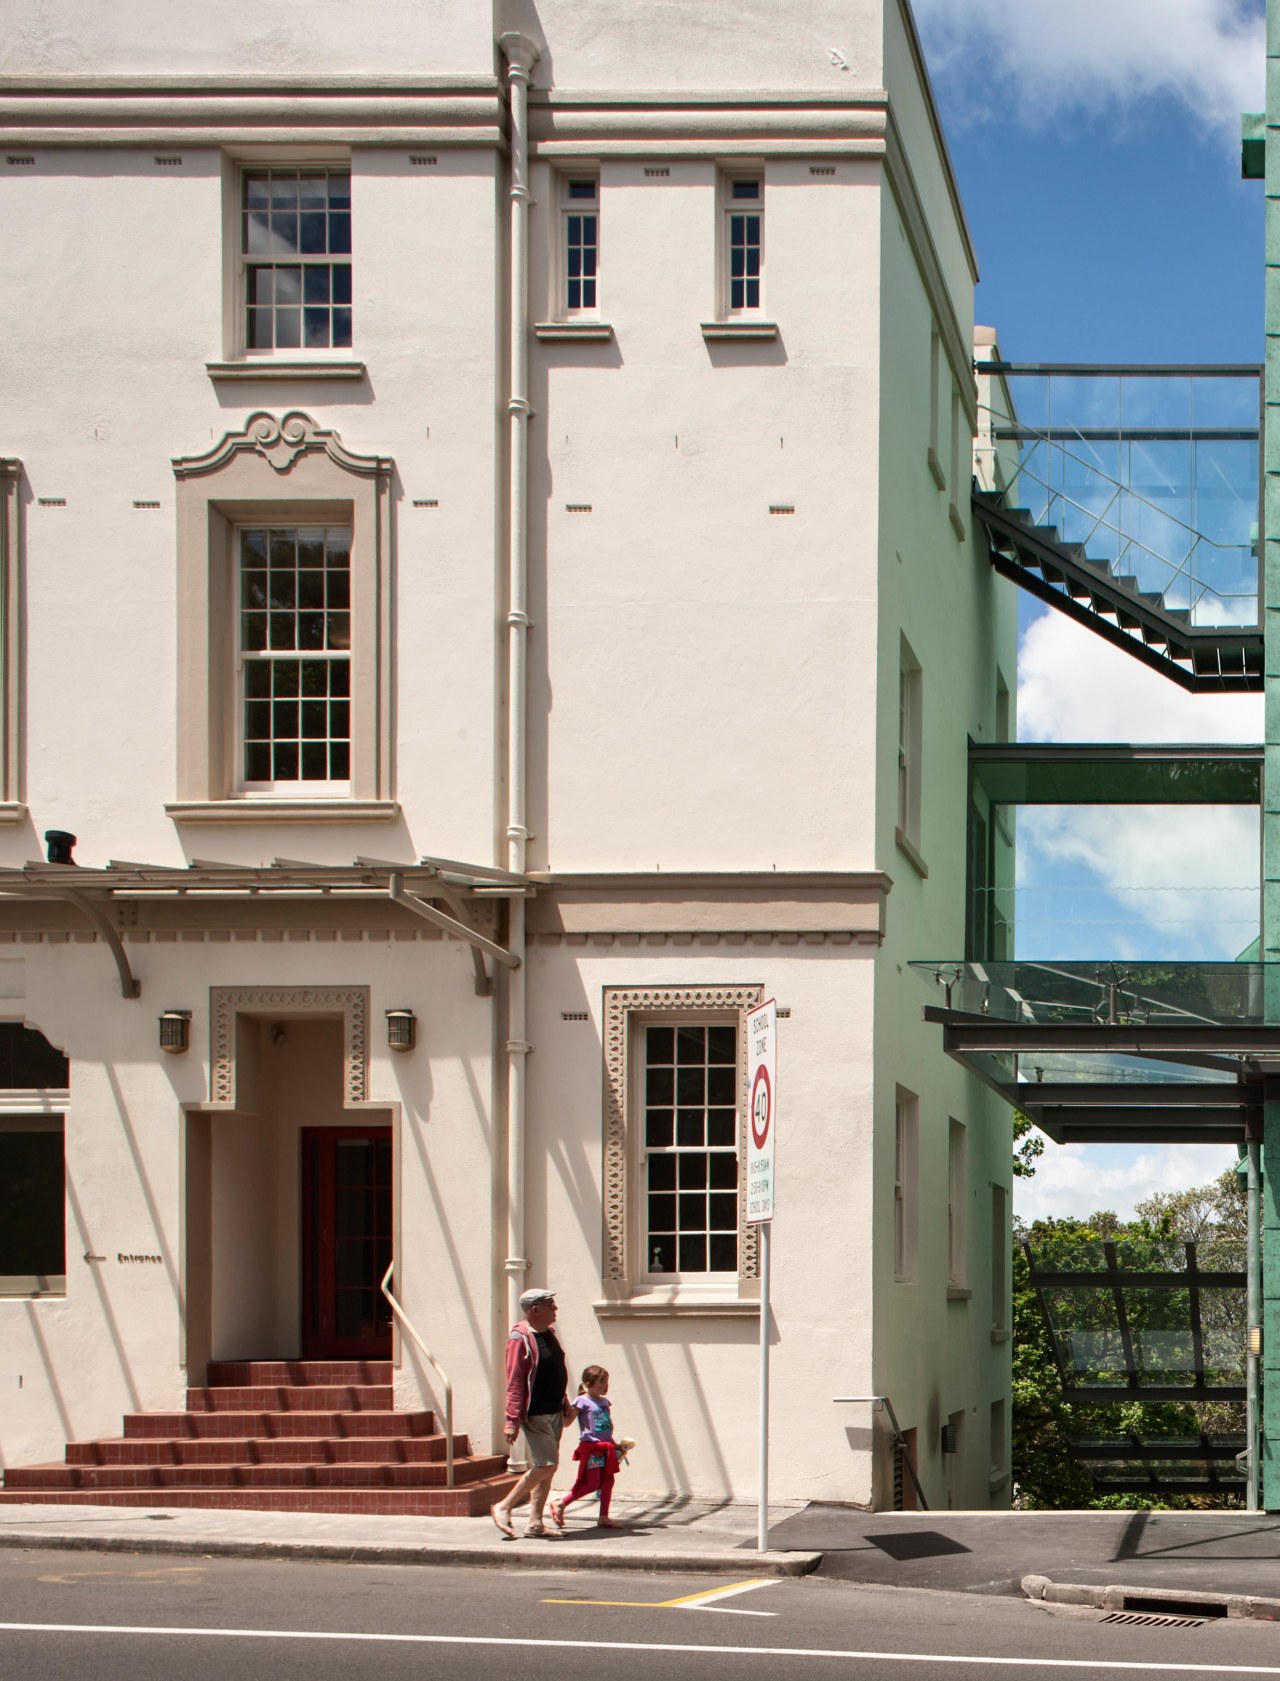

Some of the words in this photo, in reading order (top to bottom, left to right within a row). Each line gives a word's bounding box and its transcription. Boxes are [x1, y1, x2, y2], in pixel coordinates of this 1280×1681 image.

[753, 1013, 769, 1034] SCHOOL
[756, 1036, 767, 1056] ZONE
[755, 1091, 767, 1123] 40
[117, 1252, 163, 1263] Entrance
